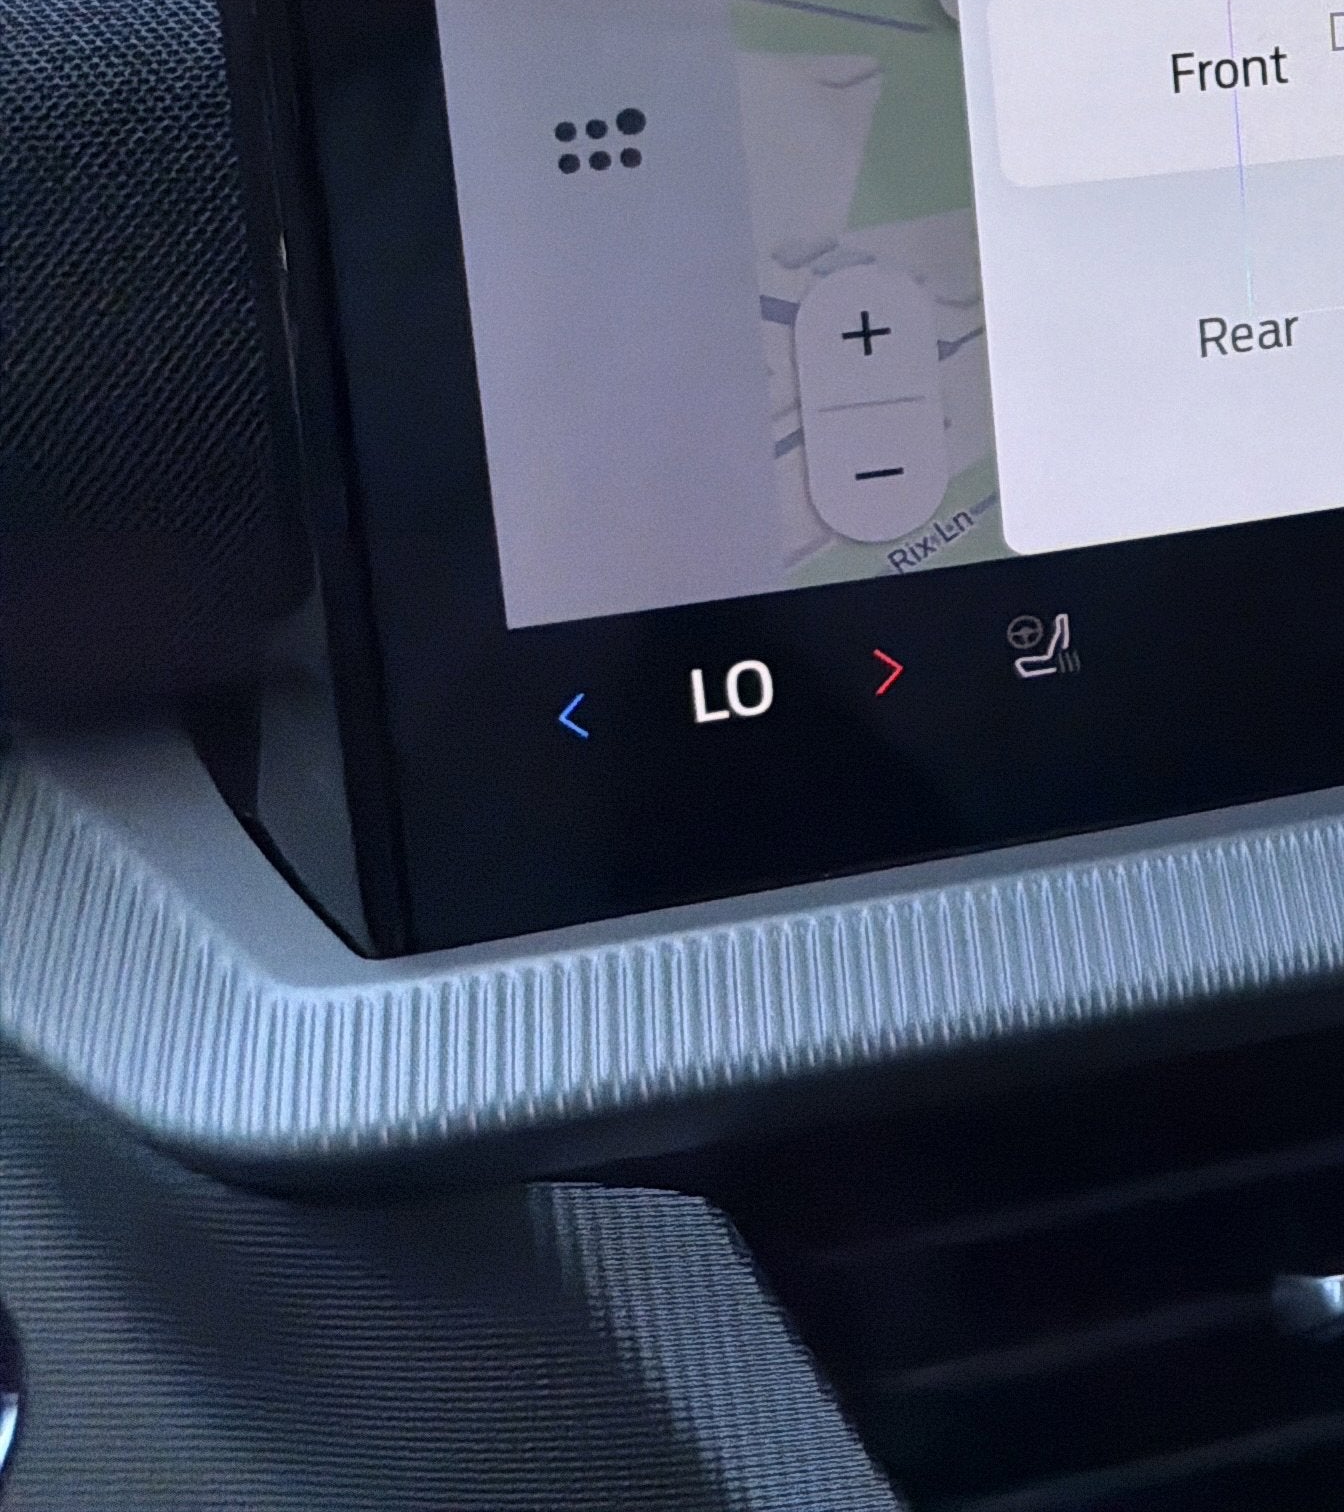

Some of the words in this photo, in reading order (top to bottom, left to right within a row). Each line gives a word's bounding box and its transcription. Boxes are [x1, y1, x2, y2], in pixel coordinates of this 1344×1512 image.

[1171, 45, 1289, 94] Front
[1198, 315, 1299, 358] Rear
[887, 535, 935, 575] Rix
[934, 508, 975, 543] Ln
[690, 659, 774, 724] LO
